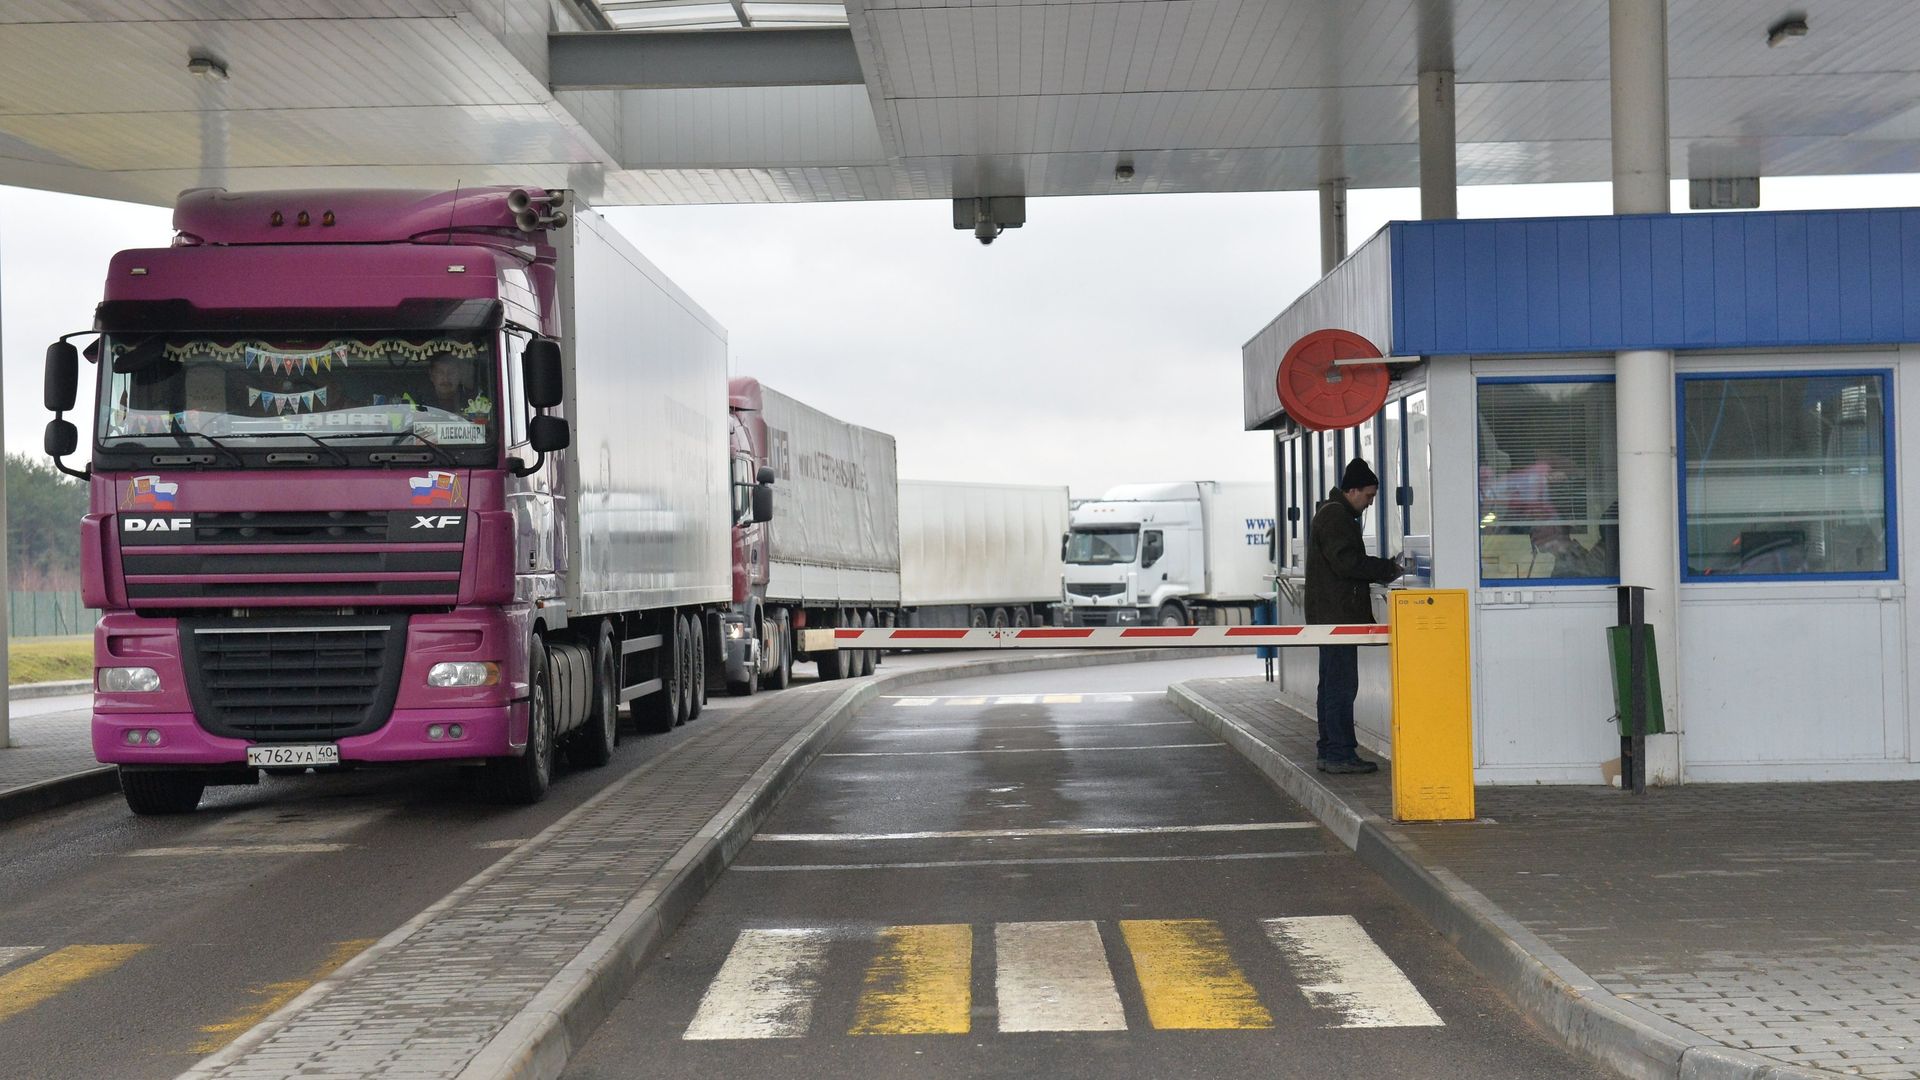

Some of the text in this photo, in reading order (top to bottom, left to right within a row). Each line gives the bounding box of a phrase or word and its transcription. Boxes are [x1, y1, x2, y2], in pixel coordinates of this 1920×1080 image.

[440, 426, 480, 440] АЛЕКСАНДР
[125, 518, 191, 531] DAF
[410, 515, 461, 528] XF
